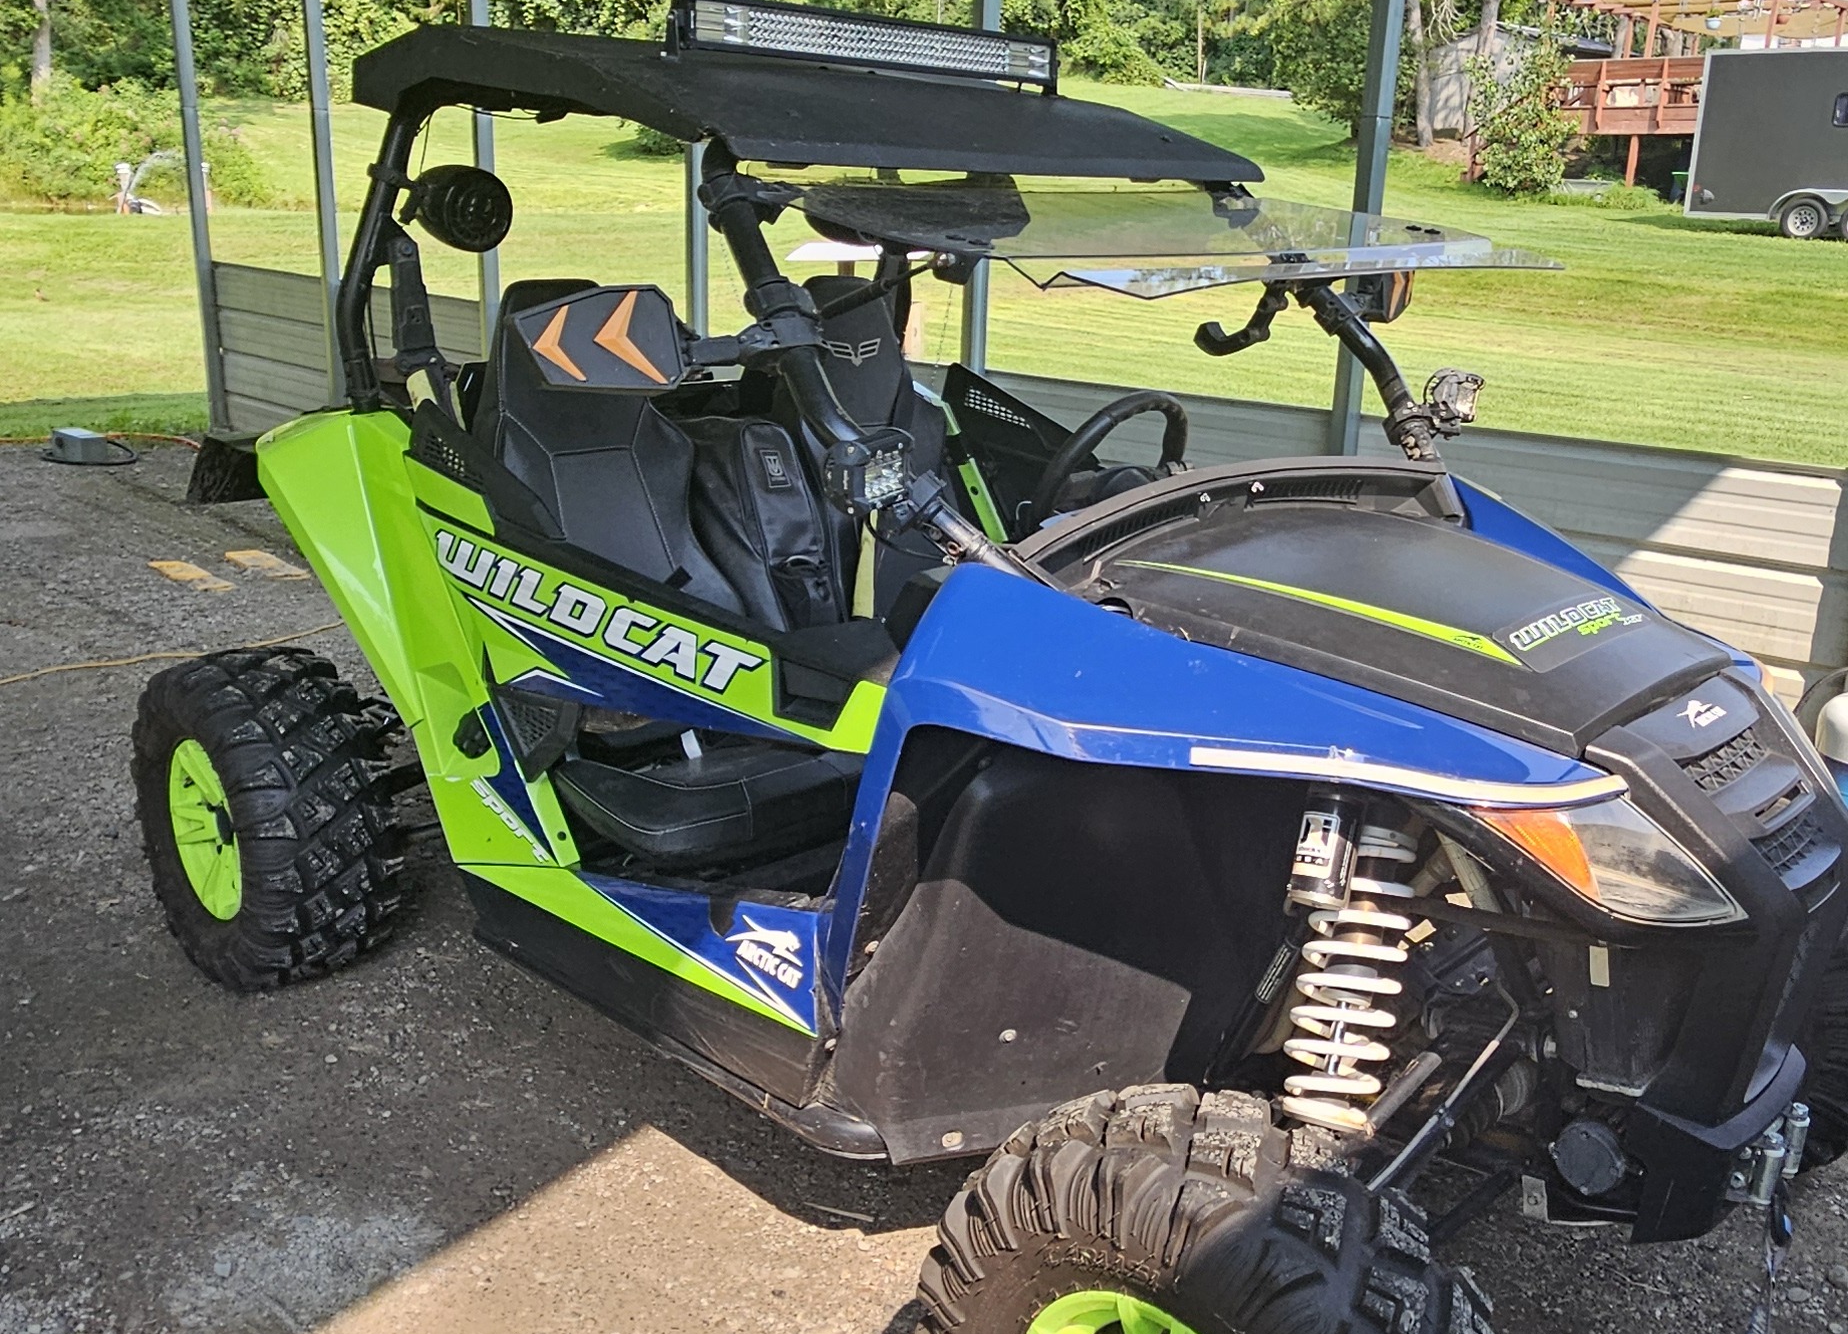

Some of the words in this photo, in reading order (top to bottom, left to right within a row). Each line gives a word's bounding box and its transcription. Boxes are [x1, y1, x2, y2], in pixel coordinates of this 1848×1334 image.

[436, 529, 768, 693] WILDCAT
[1509, 597, 1621, 651] WILDCAT
[1577, 613, 1626, 635] sport
[470, 779, 549, 864] sport
[736, 939, 781, 976] ARCTIC
[776, 962, 803, 989] CAT
